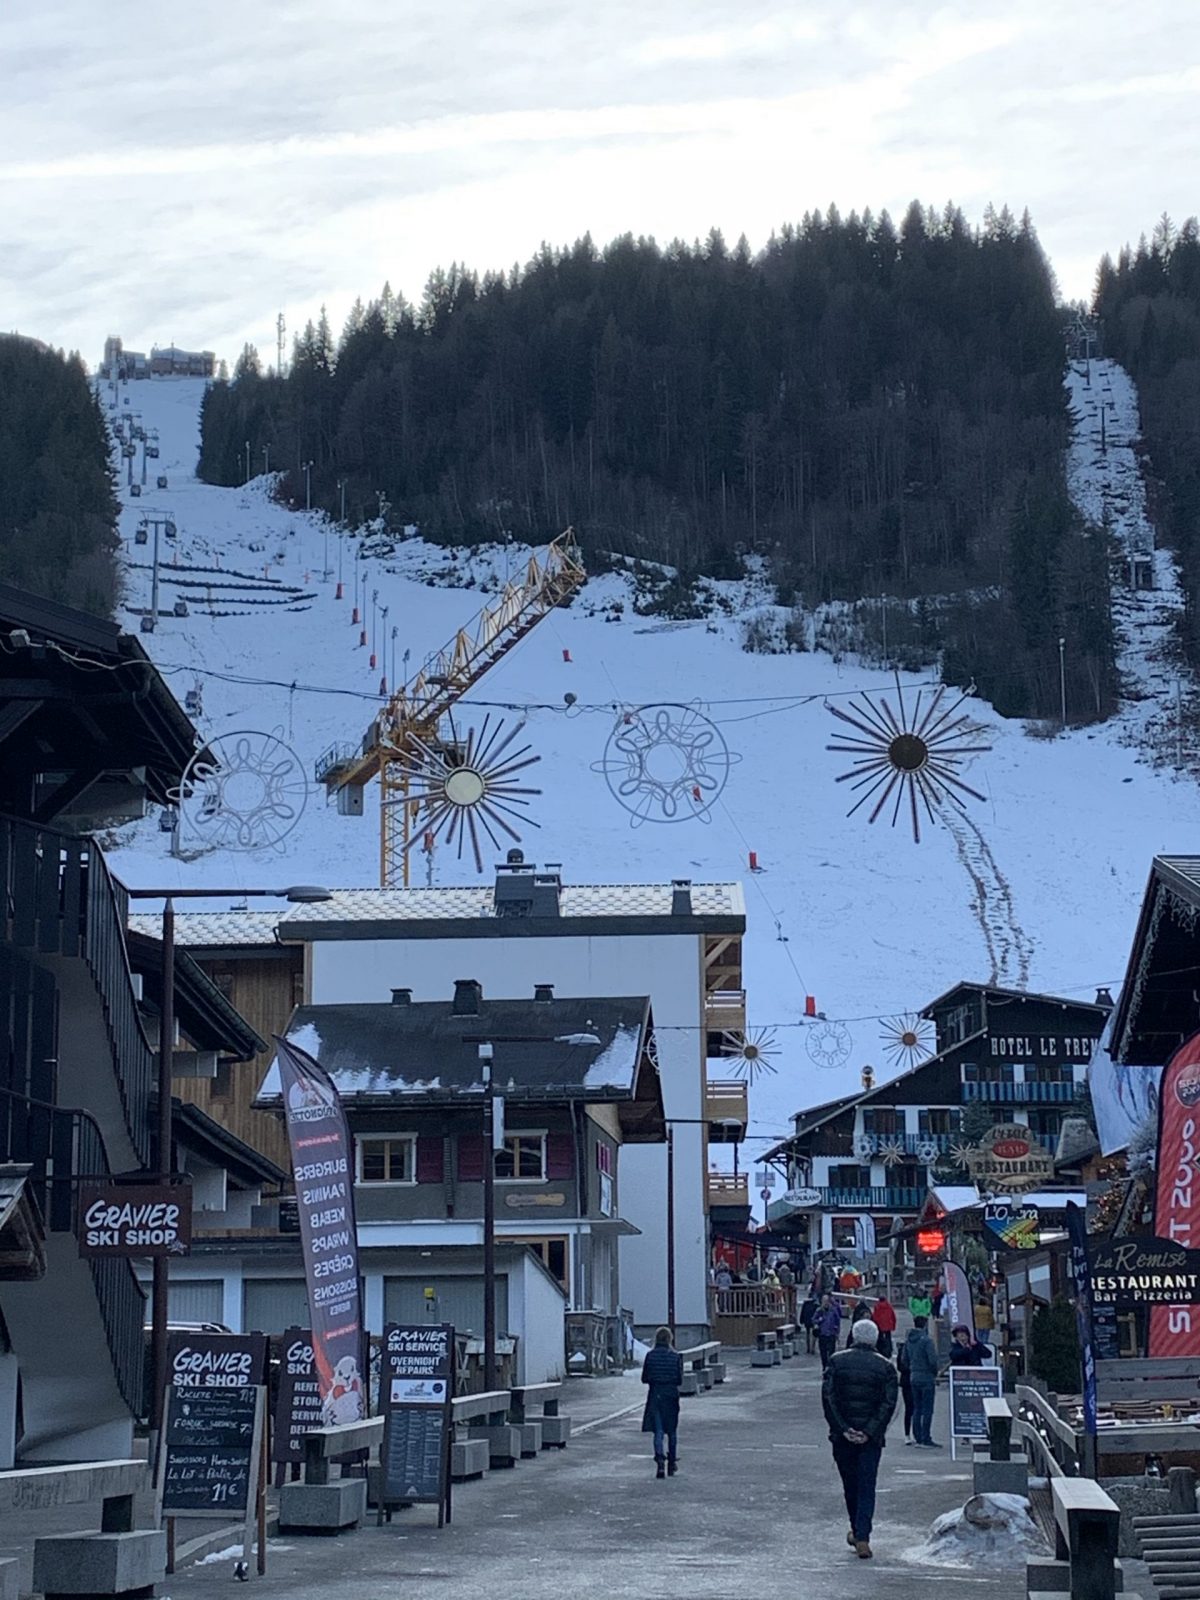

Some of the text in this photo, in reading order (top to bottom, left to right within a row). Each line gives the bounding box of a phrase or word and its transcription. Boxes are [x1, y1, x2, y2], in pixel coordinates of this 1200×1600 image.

[991, 1037, 1032, 1056] HOTEL
[1040, 1037, 1056, 1056] LE
[974, 1161, 1049, 1174] RESTAURANT
[85, 1200, 179, 1229] GRAVIER
[87, 1229, 177, 1246] SKI SHOP
[1113, 1243, 1188, 1272] Remise
[1094, 1290, 1118, 1302] Bar
[1134, 1289, 1193, 1301] Pizzeria
[388, 1329, 448, 1342] GRAVIER
[387, 1342, 446, 1352] SKI SERVICE
[173, 1347, 252, 1374] GRAVIER
[390, 1356, 440, 1367] OVERNIGHT
[287, 1362, 311, 1375] SKI
[396, 1365, 434, 1375] REPAIRS
[172, 1373, 249, 1387] SKI SHOP
